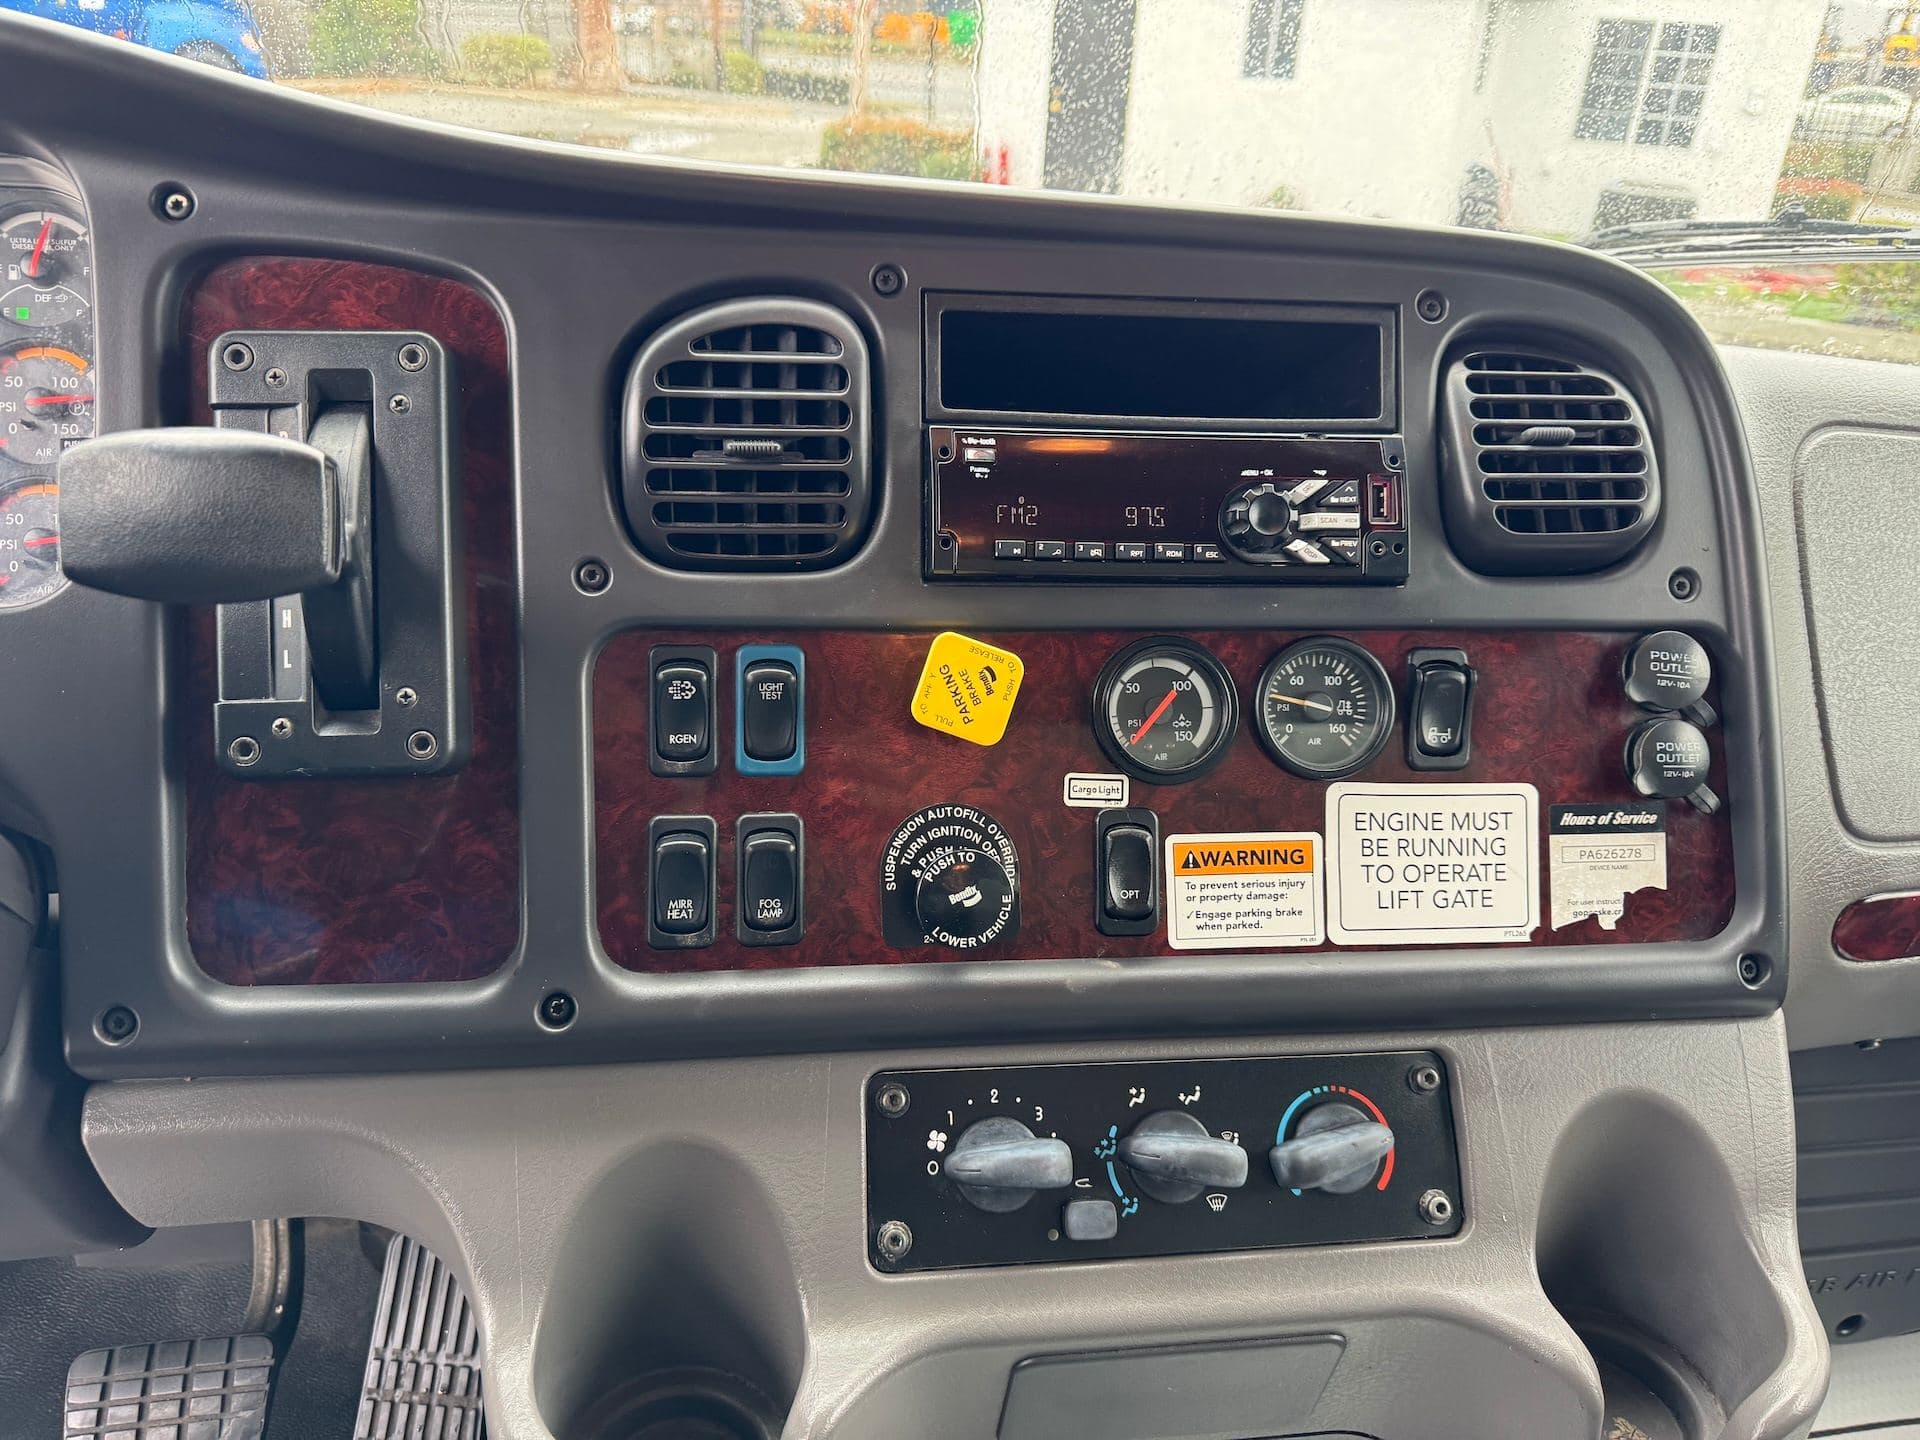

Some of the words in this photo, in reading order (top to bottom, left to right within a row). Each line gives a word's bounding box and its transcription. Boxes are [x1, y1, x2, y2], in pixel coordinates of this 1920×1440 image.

[83, 266, 90, 276] F
[34, 293, 52, 303] DEF
[3, 307, 10, 317] E
[4, 376, 23, 388] 50
[52, 376, 79, 389] 100
[0, 401, 16, 412] PSI
[8, 422, 18, 434] 0
[52, 423, 79, 435] 150
[35, 448, 53, 457] AIR
[5, 513, 24, 525] 50
[996, 504, 1038, 525] FM2
[0, 539, 17, 550] PSI
[1205, 551, 1219, 559] ESC
[9, 561, 19, 572] 0
[36, 586, 53, 594] AIR
[282, 609, 292, 629] H
[284, 650, 292, 669] L
[968, 645, 1005, 664] RELEASE
[1007, 661, 1017, 673] TO
[978, 670, 995, 696] Bendix
[1171, 680, 1193, 692] 100
[1289, 675, 1305, 686] 60
[1324, 676, 1342, 686] 100
[758, 682, 785, 692] LIGHT
[958, 668, 982, 706] BRAKE
[1002, 679, 1015, 702] PUSH
[1125, 682, 1141, 693] 50
[760, 691, 783, 700] TEST
[939, 664, 975, 725] PARKING
[1276, 703, 1290, 712] PSI
[935, 714, 954, 727] PULL
[1127, 719, 1142, 728] PSI
[1285, 723, 1294, 734] 0
[1329, 723, 1347, 734] 160
[669, 734, 697, 744] RGEN
[1174, 730, 1194, 742] 150
[1307, 737, 1322, 745] AIR
[1656, 742, 1700, 752] POWER
[1153, 753, 1169, 761] AIR
[1656, 752, 1700, 763] OUTLET
[1072, 785, 1097, 796] Cargo
[1098, 785, 1120, 796] Light
[1354, 812, 1444, 831] ENGINE
[1450, 811, 1513, 831] MUST
[1559, 812, 1596, 826] Hours
[1597, 811, 1614, 825] of
[1612, 811, 1658, 825] Service
[885, 815, 926, 891] SUSPENSION
[927, 806, 988, 828] AUTOFILL
[900, 835, 928, 867] TURN
[928, 825, 983, 845] IGNITION
[1360, 837, 1389, 857] BE
[1397, 836, 1507, 857] RUNNING
[1200, 848, 1305, 867] WARNING
[1579, 848, 1642, 860] PA626278
[924, 853, 956, 883] PUSH
[957, 851, 976, 863] TO
[1361, 864, 1395, 883] TO
[1402, 863, 1507, 883] OPERATE
[911, 869, 922, 878] &
[1185, 881, 1197, 890] To
[1200, 881, 1238, 892] prevent
[1241, 879, 1276, 889] serious
[1279, 878, 1306, 890] injury
[948, 884, 978, 905] Bendix
[1120, 889, 1140, 900] OPT
[1186, 894, 1197, 902] or
[1200, 892, 1243, 905] property
[1246, 891, 1289, 902] damage:
[1377, 890, 1424, 909] LIFT
[1432, 889, 1493, 909] GATE
[668, 899, 693, 909] MIRR
[759, 898, 781, 908] FOG
[667, 909, 694, 919] HEAT
[757, 908, 783, 918] LAMP
[1195, 910, 1232, 921] Engage
[1235, 908, 1272, 920] parking
[1275, 907, 1303, 917] brake
[932, 926, 977, 948] LOWER
[978, 894, 1012, 944] VEHICLE
[1196, 921, 1223, 931] when
[1226, 919, 1264, 931] parked.
[990, 1088, 999, 1103] 2
[947, 1110, 954, 1126] 1
[1035, 1106, 1044, 1121] 3
[927, 1160, 939, 1175] 0
